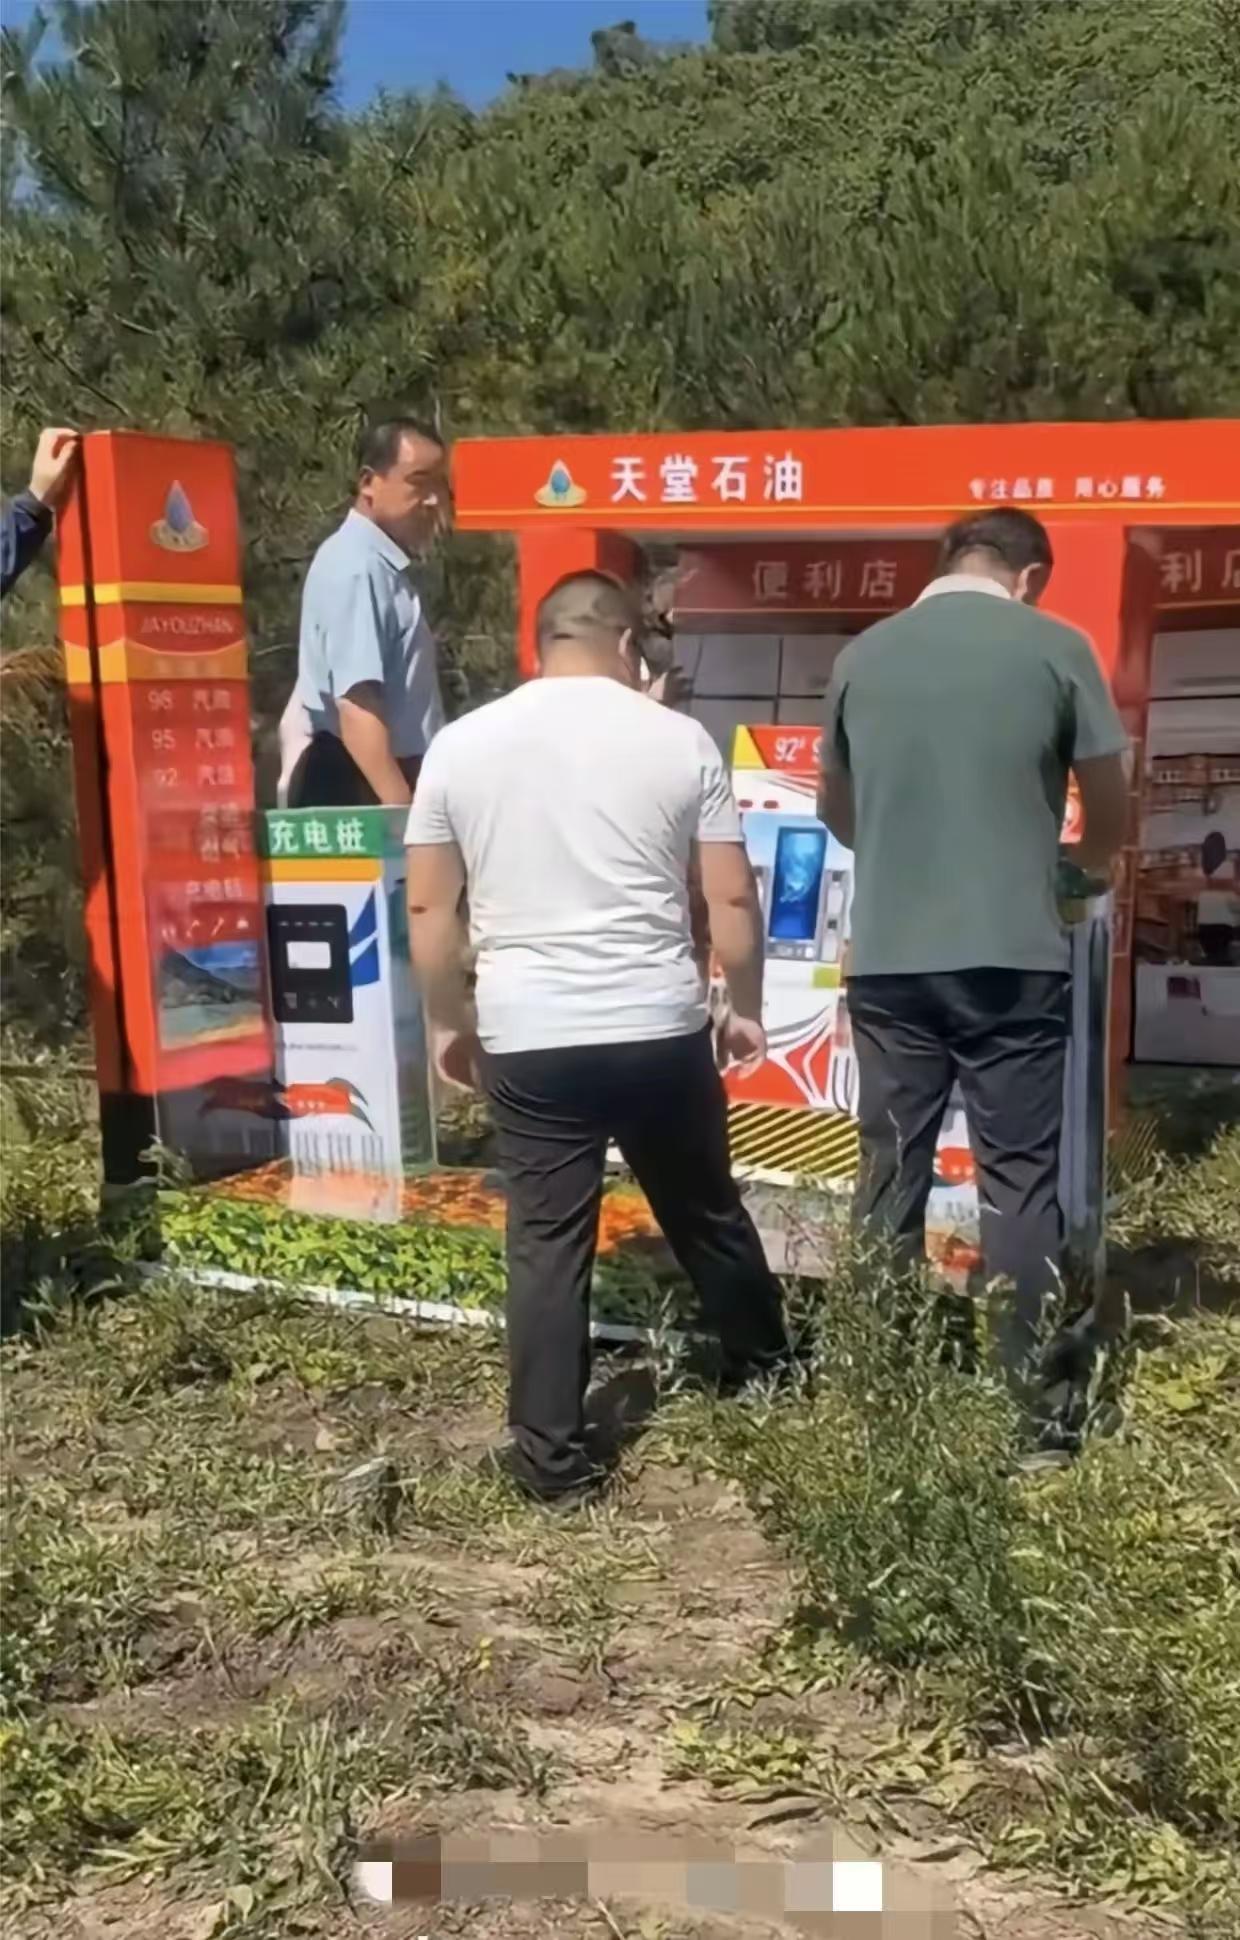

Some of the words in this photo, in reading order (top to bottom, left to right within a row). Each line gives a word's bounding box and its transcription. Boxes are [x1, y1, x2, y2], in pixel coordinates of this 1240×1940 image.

[611, 451, 802, 502] 天堂石油
[752, 559, 898, 599] 便利店
[152, 728, 177, 750] 95
[268, 817, 367, 854] 充电桩
